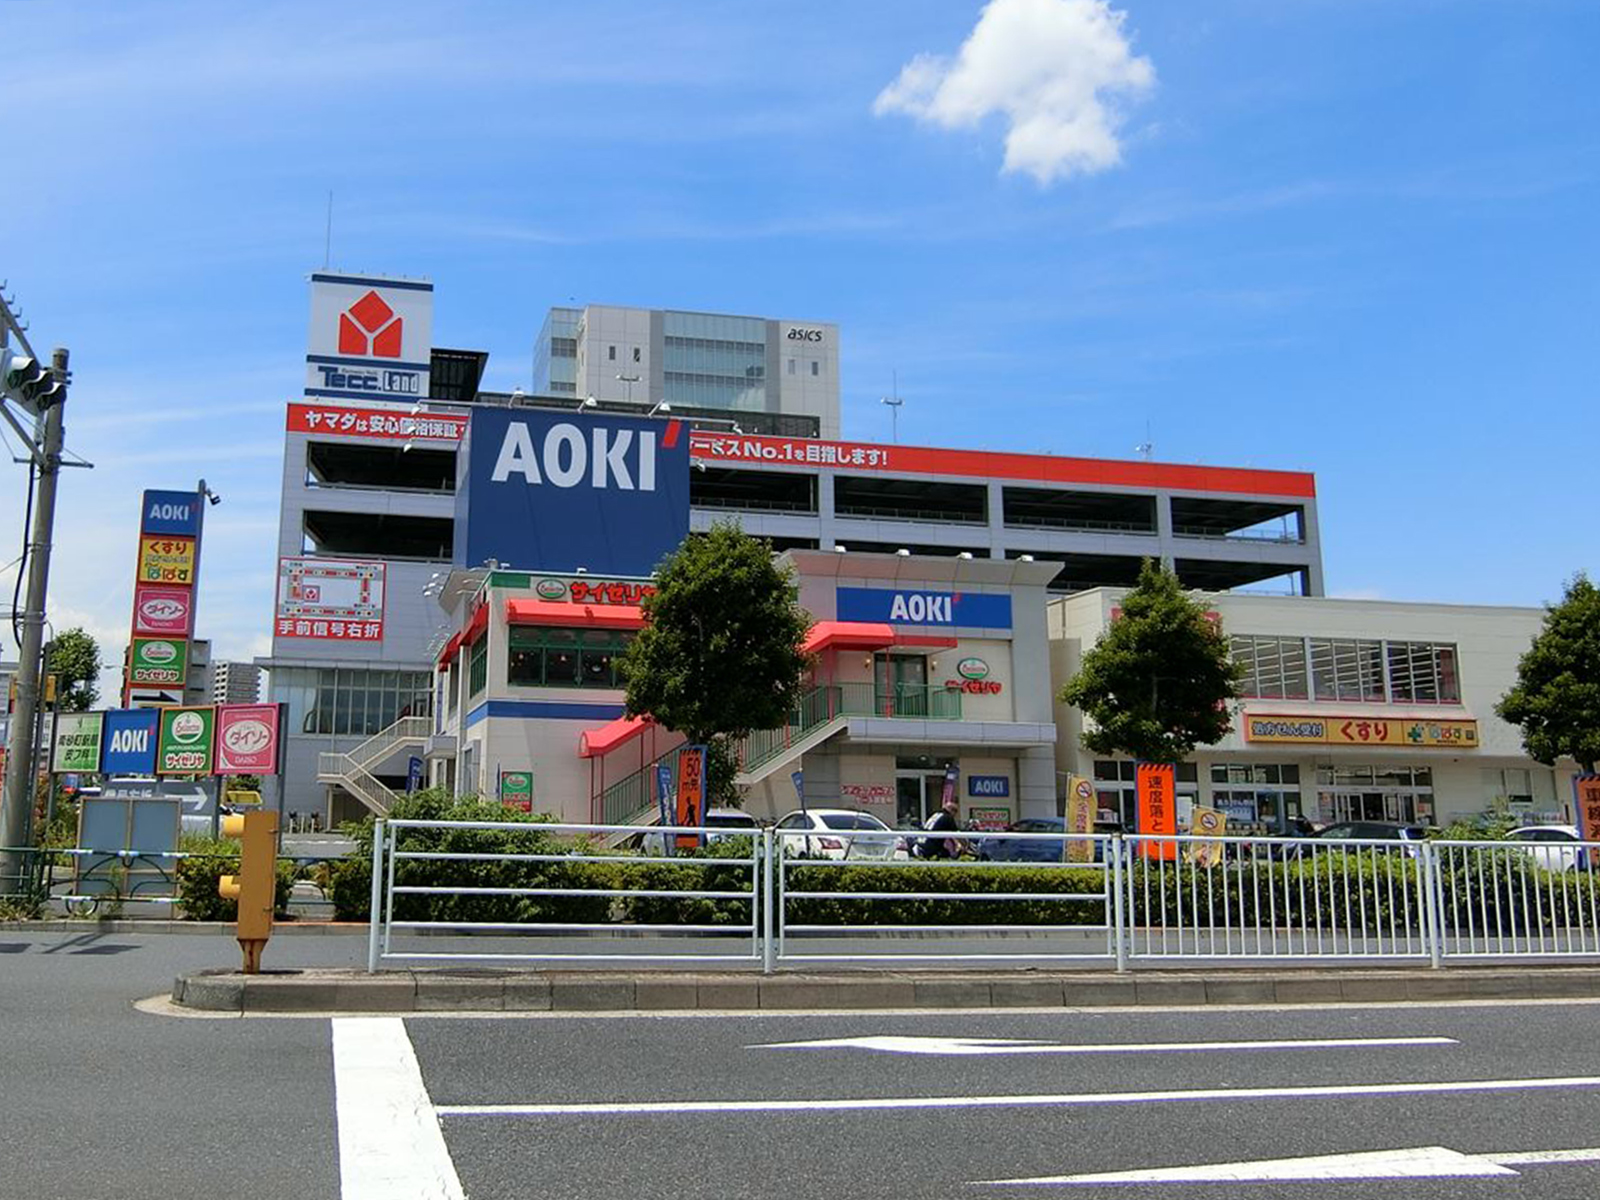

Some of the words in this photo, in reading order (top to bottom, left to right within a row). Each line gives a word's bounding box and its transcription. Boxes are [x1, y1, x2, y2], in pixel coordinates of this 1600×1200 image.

[787, 328, 822, 342] asics
[149, 503, 190, 521] AOKI
[149, 541, 187, 555] くすり
[146, 604, 184, 615] ダイソー
[890, 594, 952, 622] AOKI
[279, 620, 380, 638] 手前信号右折
[136, 669, 179, 680] サイゼリヤ
[1253, 722, 1323, 737] 処方せん受付
[1341, 722, 1388, 741] くすり
[110, 729, 148, 753] AOKI
[230, 730, 267, 745] ダイソー
[166, 753, 205, 768] サイゼリヤ
[975, 782, 1004, 793] AOKI
[1149, 776, 1163, 846] 速度落と
